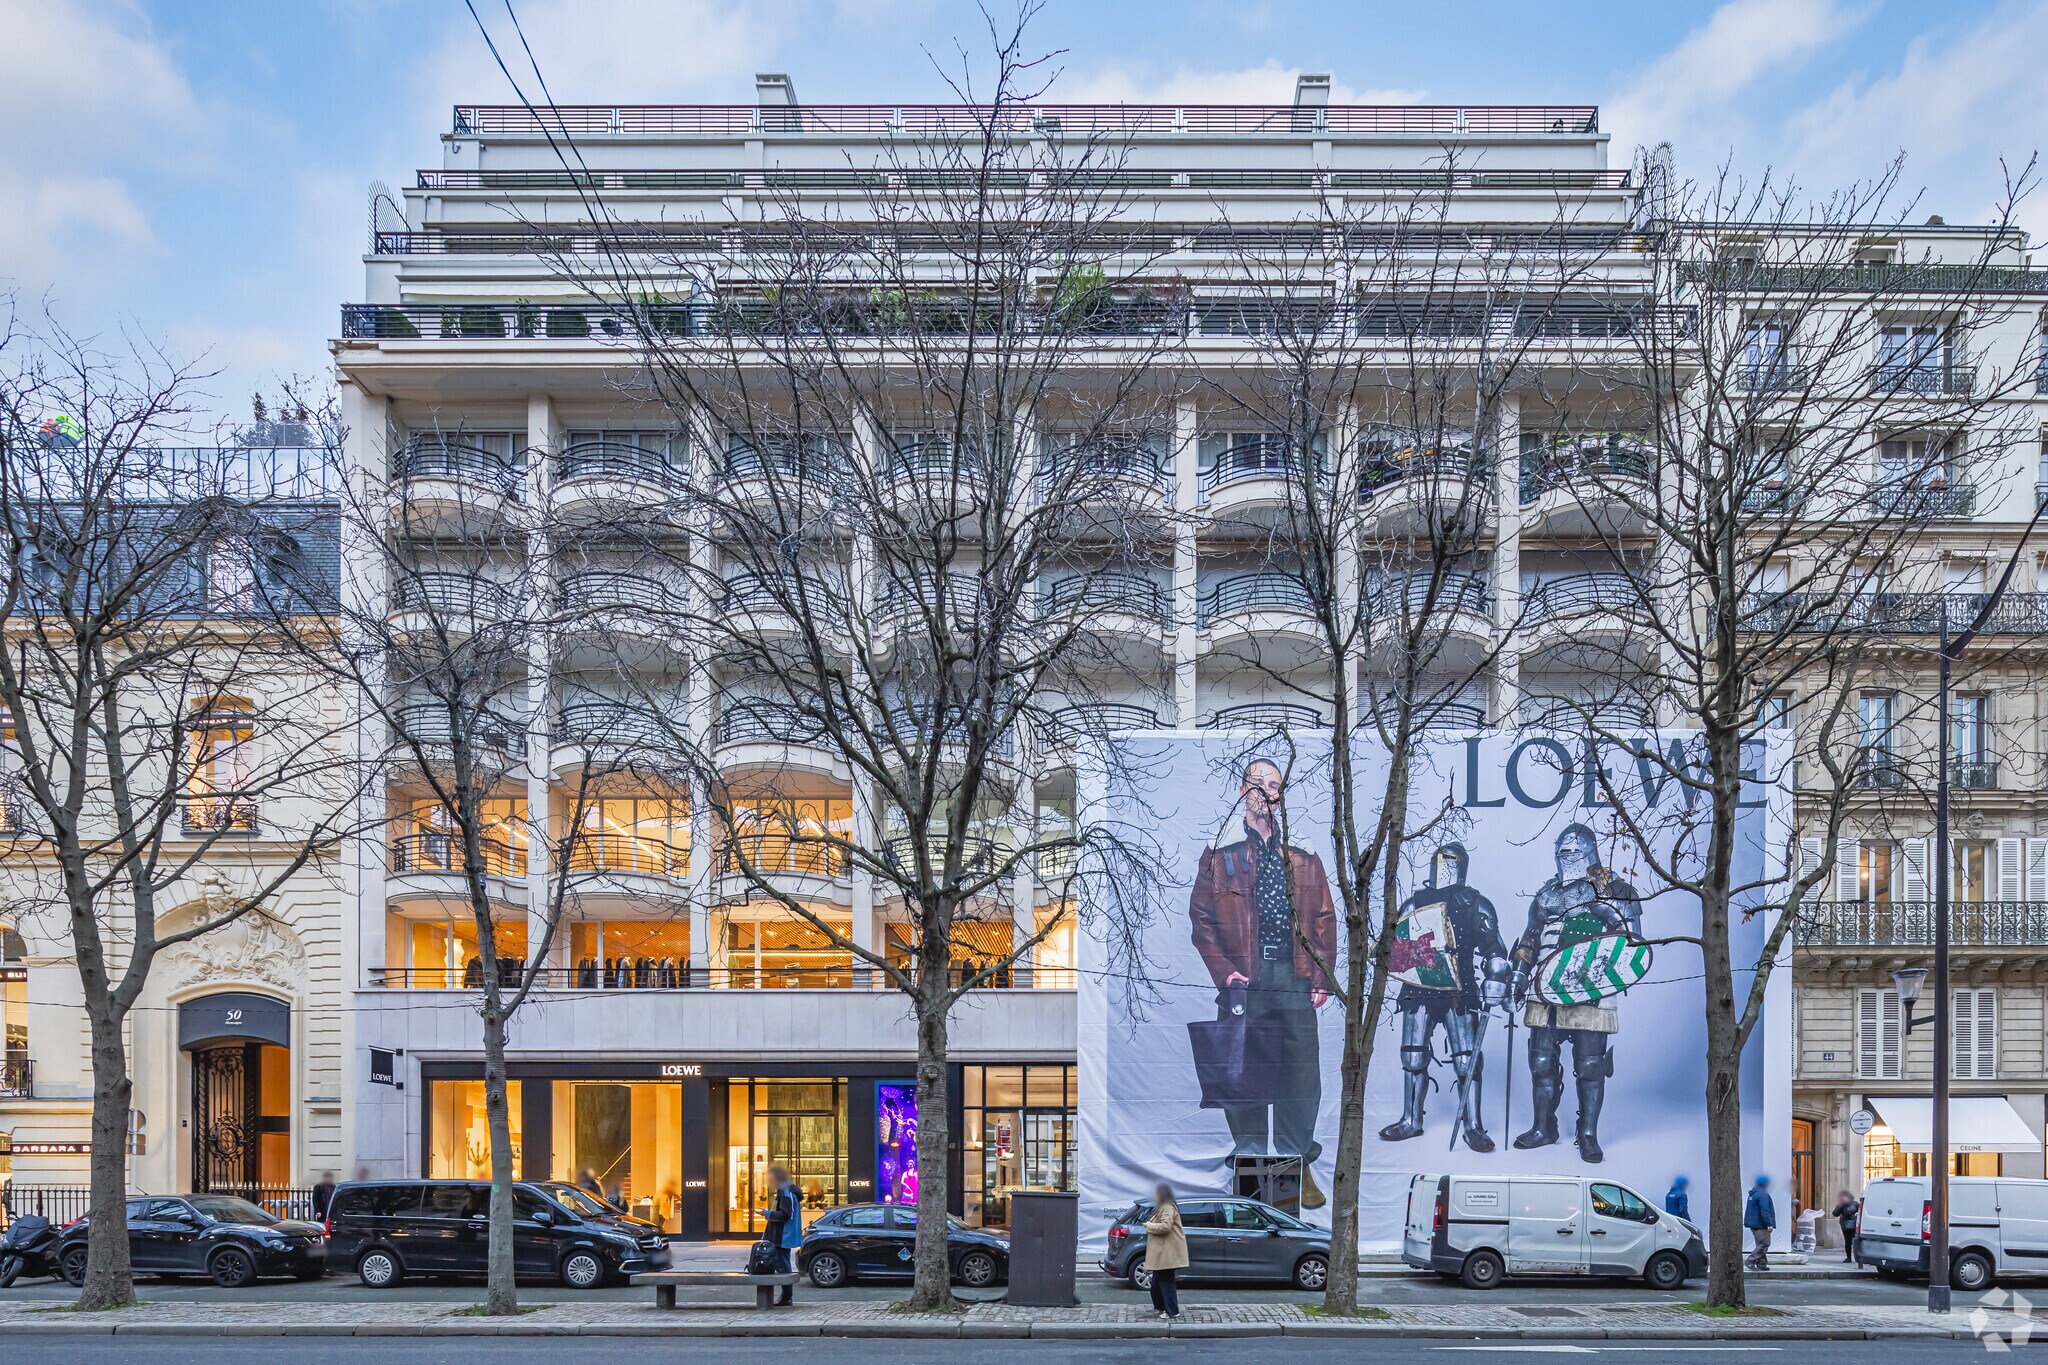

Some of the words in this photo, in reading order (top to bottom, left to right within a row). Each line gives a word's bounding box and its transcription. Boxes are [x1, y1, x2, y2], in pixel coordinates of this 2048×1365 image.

[1462, 735, 1768, 808] LOEWE
[225, 1009, 242, 1021] 50
[662, 1065, 702, 1076] LOEWE
[372, 1072, 392, 1082] LOEWE
